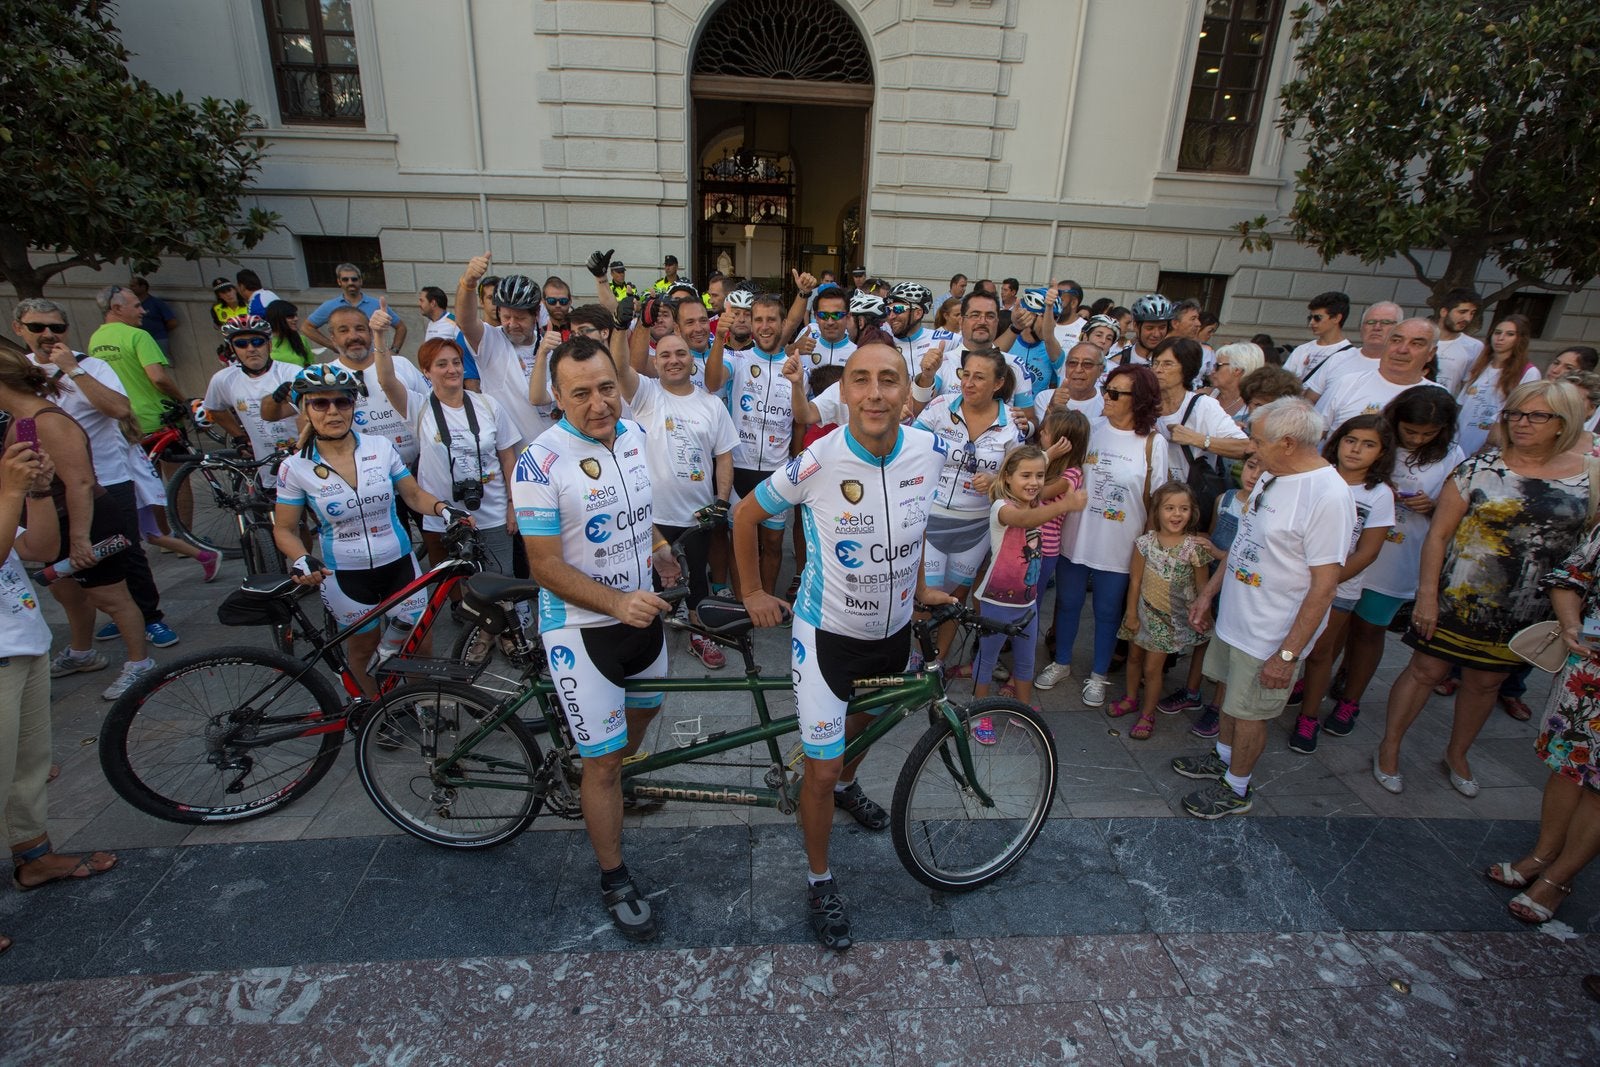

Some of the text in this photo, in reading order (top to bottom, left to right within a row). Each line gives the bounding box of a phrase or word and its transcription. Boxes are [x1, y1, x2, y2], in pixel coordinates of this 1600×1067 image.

[370, 410, 394, 420] Cuer
[757, 400, 792, 417] Cuerva
[597, 486, 616, 499] ela
[346, 492, 390, 509] Cuerva
[617, 503, 652, 530] Cuer
[850, 512, 874, 526] ela
[608, 542, 625, 556] LOS
[870, 537, 922, 563] Cuer
[859, 574, 878, 584] LOS
[845, 596, 880, 610] BMN
[559, 676, 591, 742] Cuerva
[633, 786, 758, 804] cannondale
